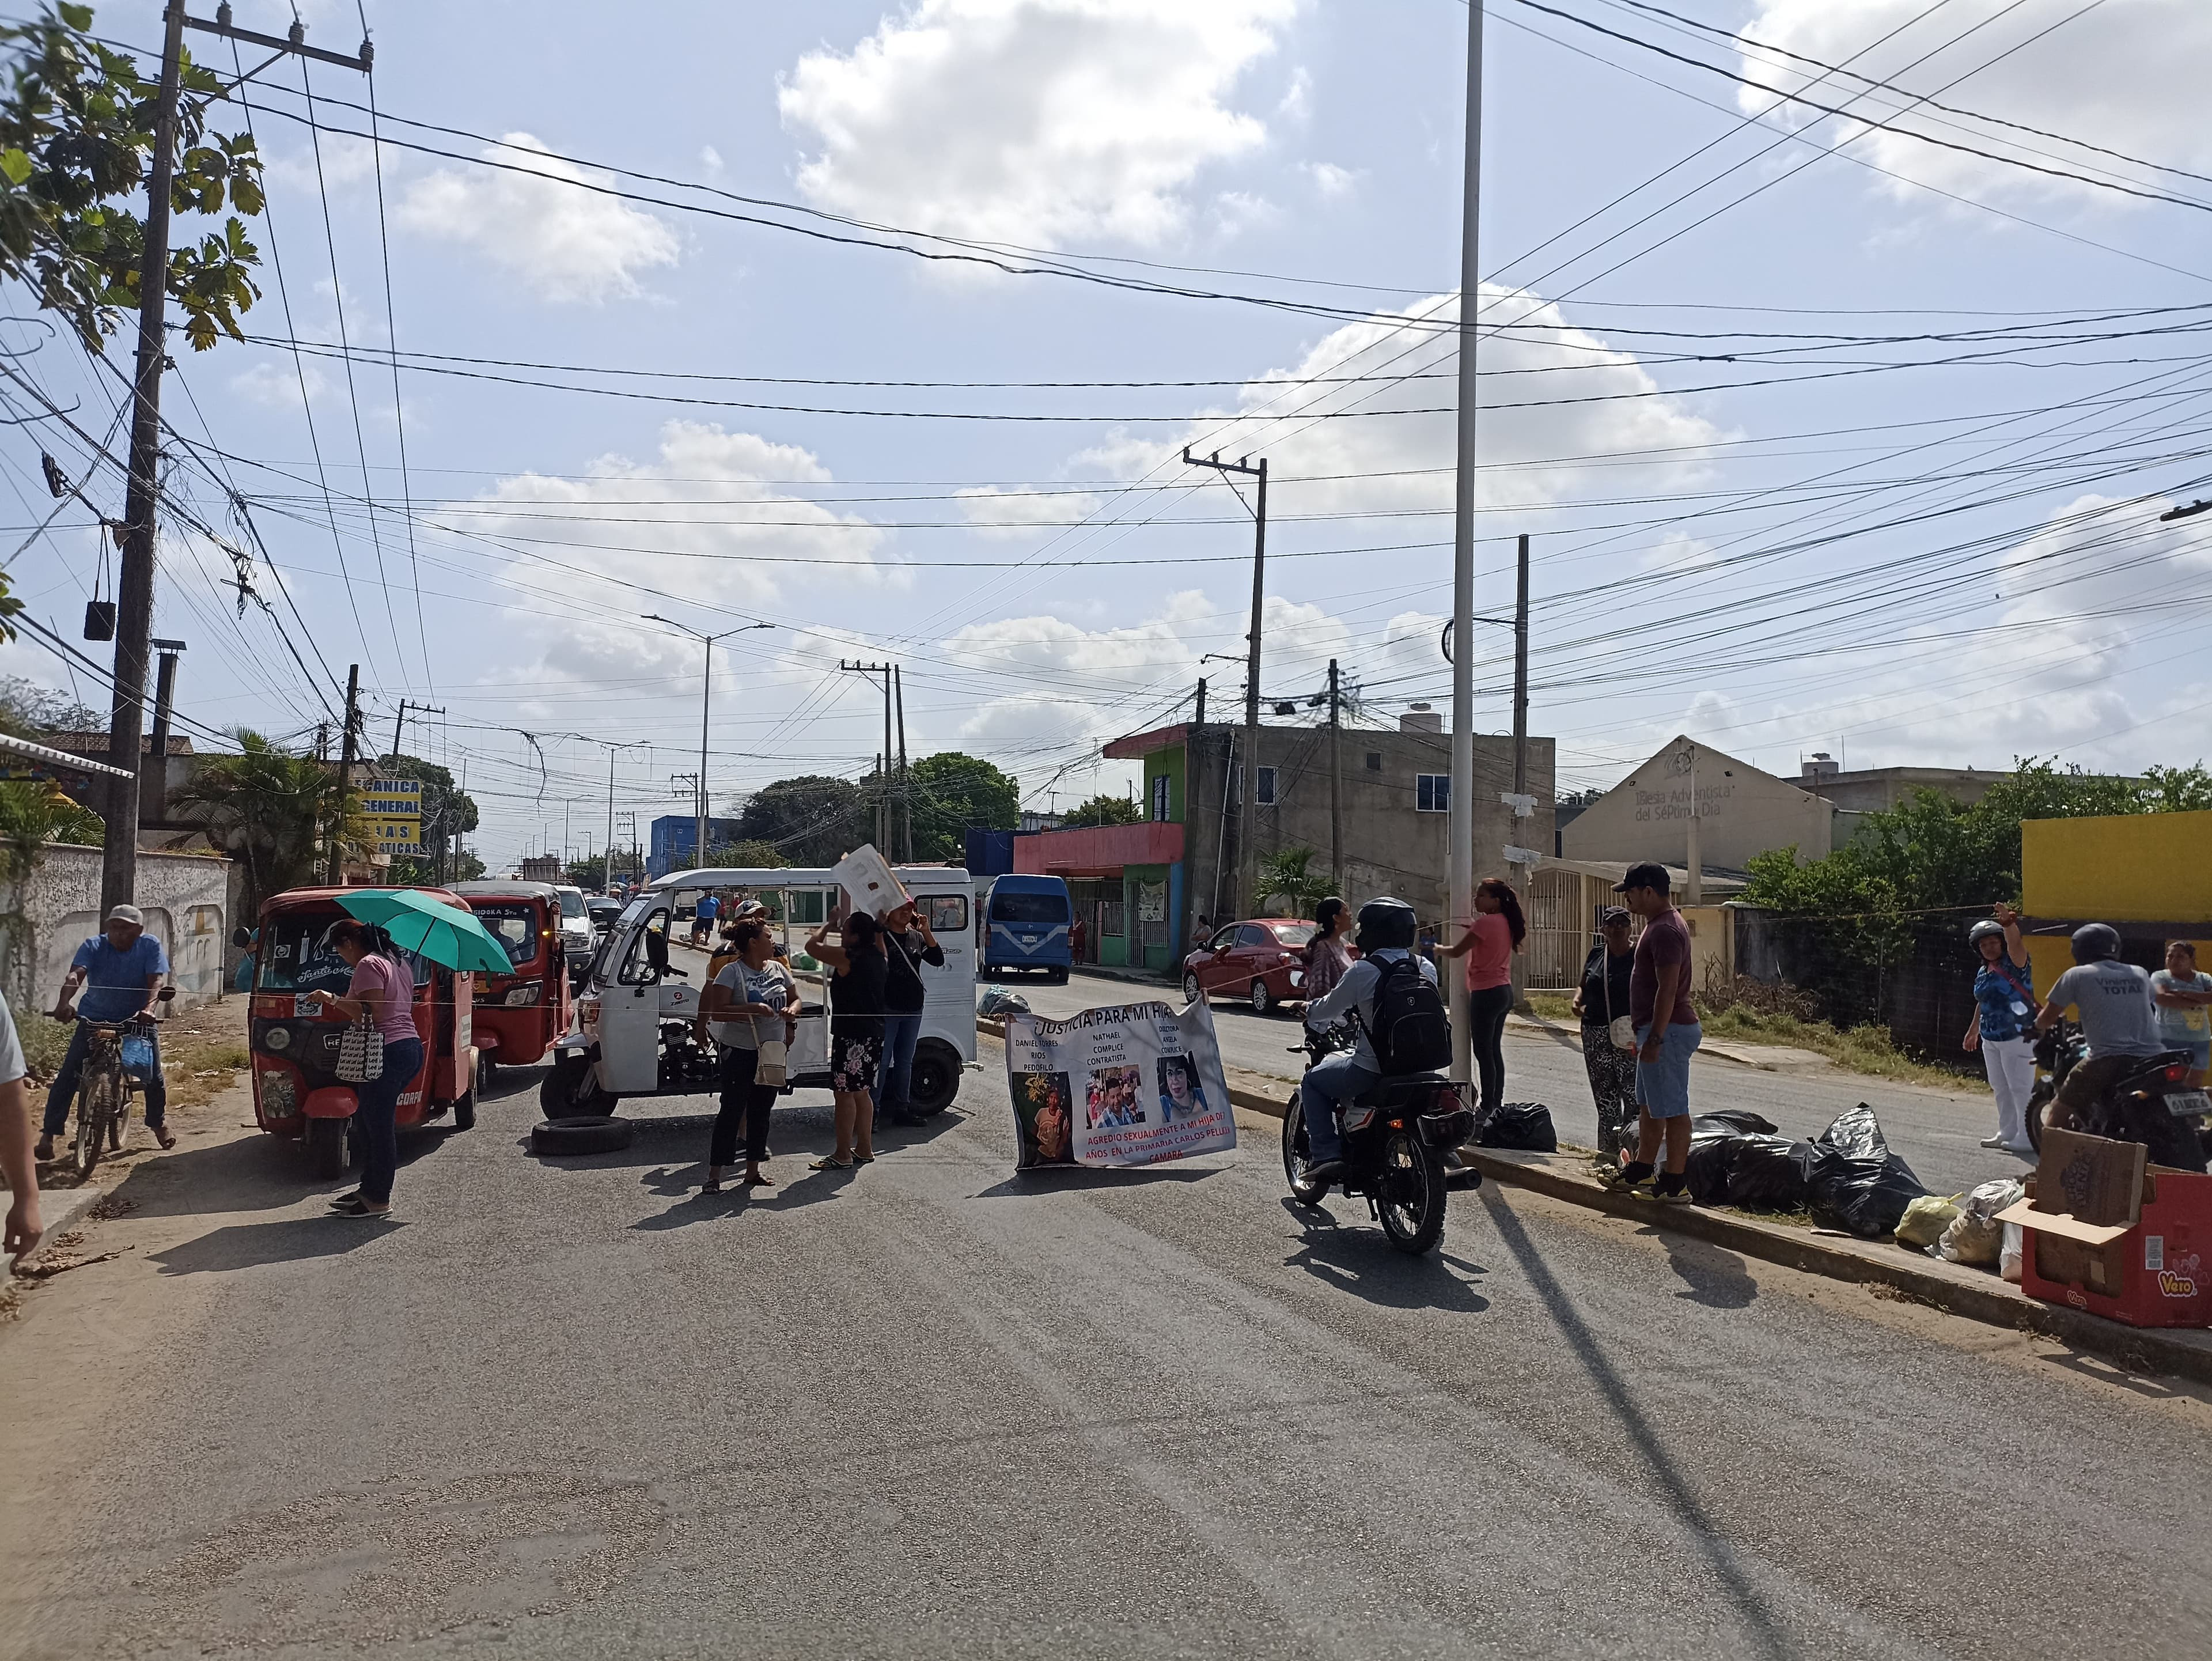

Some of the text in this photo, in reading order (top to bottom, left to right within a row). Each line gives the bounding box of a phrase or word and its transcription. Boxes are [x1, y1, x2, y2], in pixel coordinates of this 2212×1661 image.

[354, 780, 420, 793] CANICA
[361, 800, 420, 813] GENERAL
[1635, 807, 1650, 821] del
[1702, 800, 1720, 817] Día
[297, 965, 333, 983] Santa
[1096, 1007, 1131, 1026] PARA
[1132, 1005, 1149, 1021] MI
[1016, 1039, 1059, 1047] DANIEL TORRES
[1093, 1043, 1124, 1054] COMPLICE
[1087, 1054, 1126, 1065] CONTRATISTA
[1088, 1133, 1122, 1145] AGREDIO
[1124, 1125, 1179, 1141] SEXUALMENTE
[1180, 1123, 1186, 1131] A
[1187, 1120, 1197, 1129] MI
[1198, 1114, 1215, 1126] HIJA
[1086, 1149, 1108, 1160] AÑOS
[1111, 1147, 1122, 1156] EN
[1124, 1146, 1134, 1154] LA
[1135, 1138, 1173, 1152] PRIMARIA
[1175, 1131, 1205, 1144] CARLOS
[1149, 1149, 1183, 1163] CAMARA
[2162, 1274, 2191, 1293] Vero
